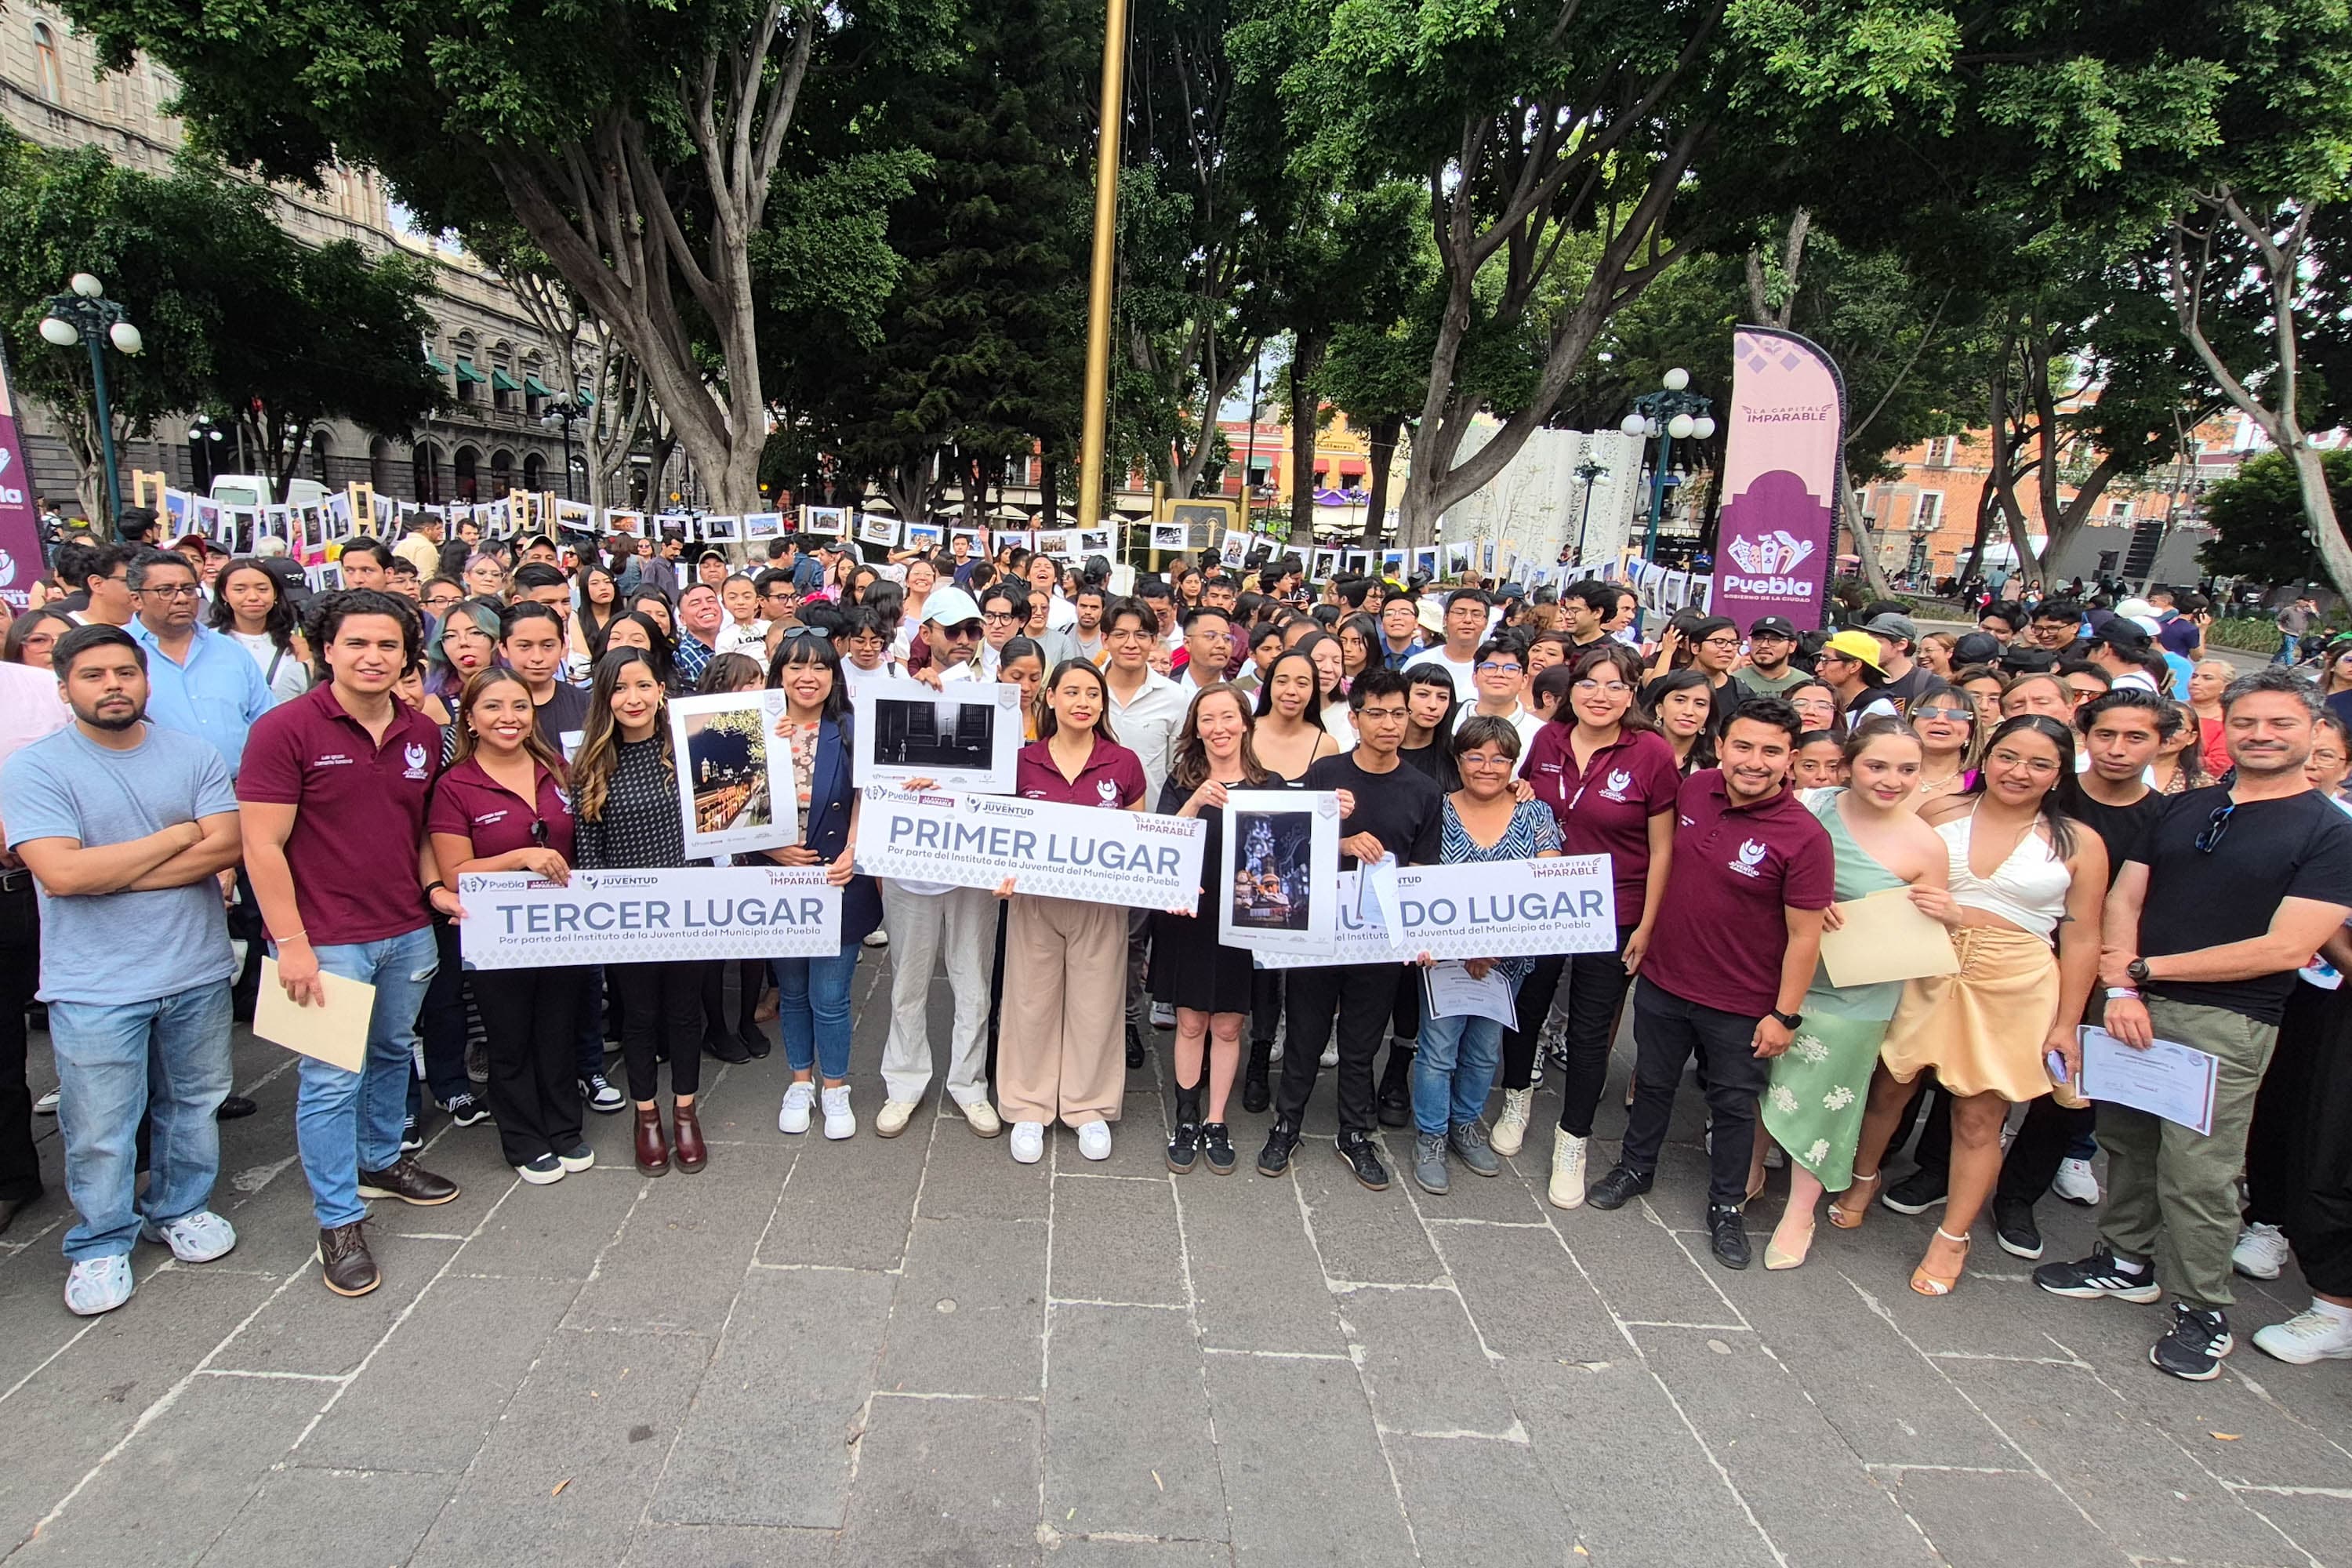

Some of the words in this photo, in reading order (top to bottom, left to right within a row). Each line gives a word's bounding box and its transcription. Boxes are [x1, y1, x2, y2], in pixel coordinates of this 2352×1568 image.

[1747, 413, 1827, 423] IMPARABLE
[1723, 575, 1813, 596] Puebla
[887, 791, 918, 802] Puebla
[982, 803, 1034, 816] JUVENTUD
[1136, 823, 1196, 837] IMPARABLE
[1155, 818, 1192, 829] CAPITAL
[890, 815, 1036, 860] PRIMER
[1047, 833, 1181, 877] LUGAR
[887, 845, 904, 855] Por
[906, 848, 932, 858] parte
[935, 849, 949, 860] del
[951, 853, 992, 866] Instituto
[993, 858, 1006, 867] de
[1008, 858, 1018, 869] la
[1019, 861, 1065, 873] Juventud
[1066, 865, 1082, 876] del
[1083, 868, 1131, 883] Municipio
[1132, 874, 1145, 884] de
[1146, 876, 1179, 887] Puebla
[1533, 866, 1599, 879] IMPARABLE
[489, 880, 524, 890] Puebla
[601, 876, 659, 886] JUVENTUD
[1468, 889, 1604, 924] LUGAR
[496, 900, 670, 935] TERCER
[684, 898, 823, 928] LUGAR
[499, 936, 518, 945] Por
[521, 934, 550, 946] parte
[554, 933, 572, 942] del
[574, 932, 620, 942] Instituto
[622, 931, 636, 940] de
[637, 930, 648, 939] la
[651, 928, 699, 938] Juventud
[702, 928, 717, 938] del
[720, 927, 770, 938] Municipio
[771, 927, 784, 935] de
[786, 926, 821, 935] Puebla
[1335, 933, 1345, 942] el
[1348, 931, 1389, 941] Instituto
[1406, 929, 1416, 938] la
[1418, 927, 1465, 937] Juventud
[1468, 926, 1483, 935] del
[1486, 924, 1537, 935] Municipio
[1555, 920, 1592, 930] Puebla
